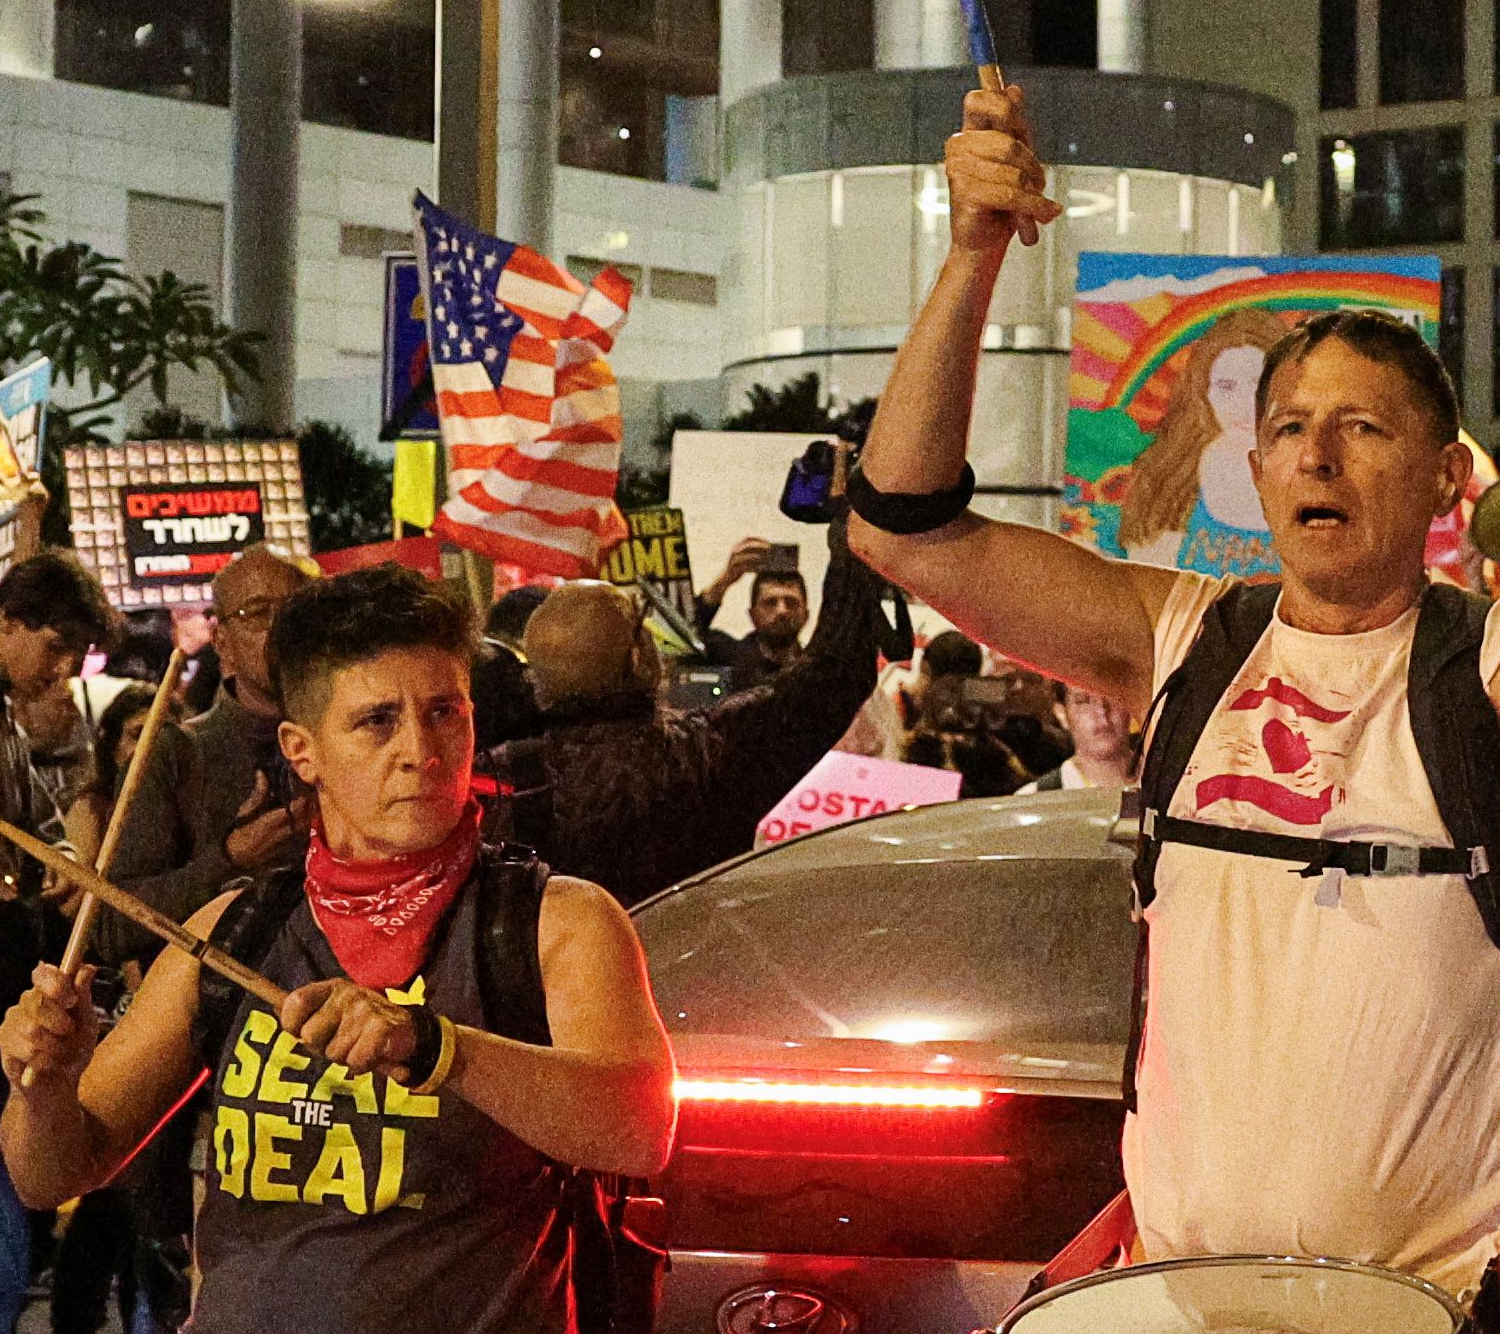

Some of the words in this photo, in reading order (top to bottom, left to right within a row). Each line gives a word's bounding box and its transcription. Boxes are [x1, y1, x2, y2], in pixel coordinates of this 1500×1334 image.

[600, 536, 691, 582] OME
[291, 1099, 334, 1128] THE
[213, 1105, 426, 1216] DEAL
